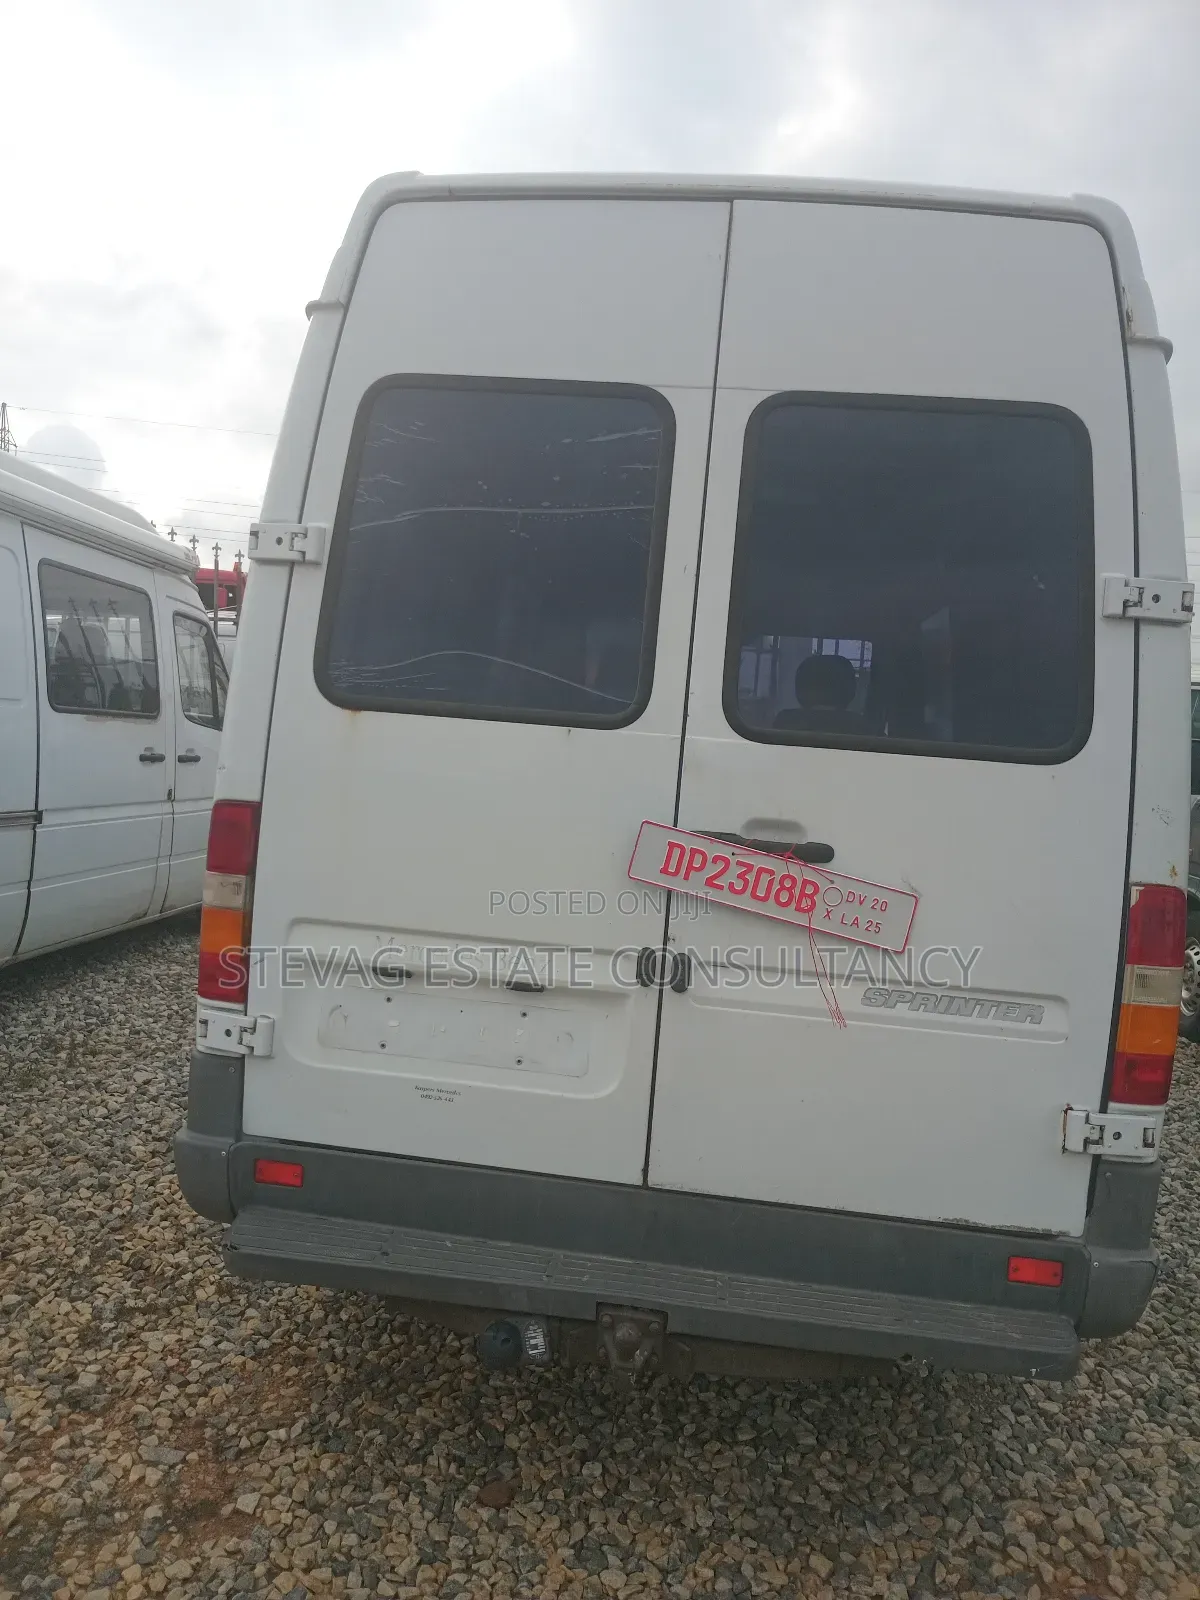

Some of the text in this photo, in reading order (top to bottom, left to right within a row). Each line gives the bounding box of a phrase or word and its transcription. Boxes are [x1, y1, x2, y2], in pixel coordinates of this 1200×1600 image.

[659, 840, 820, 914] DP2308B
[846, 890, 888, 912] DV 20
[840, 912, 860, 929] LA
[865, 919, 883, 934] 25
[861, 987, 1045, 1025] SPRINTER
